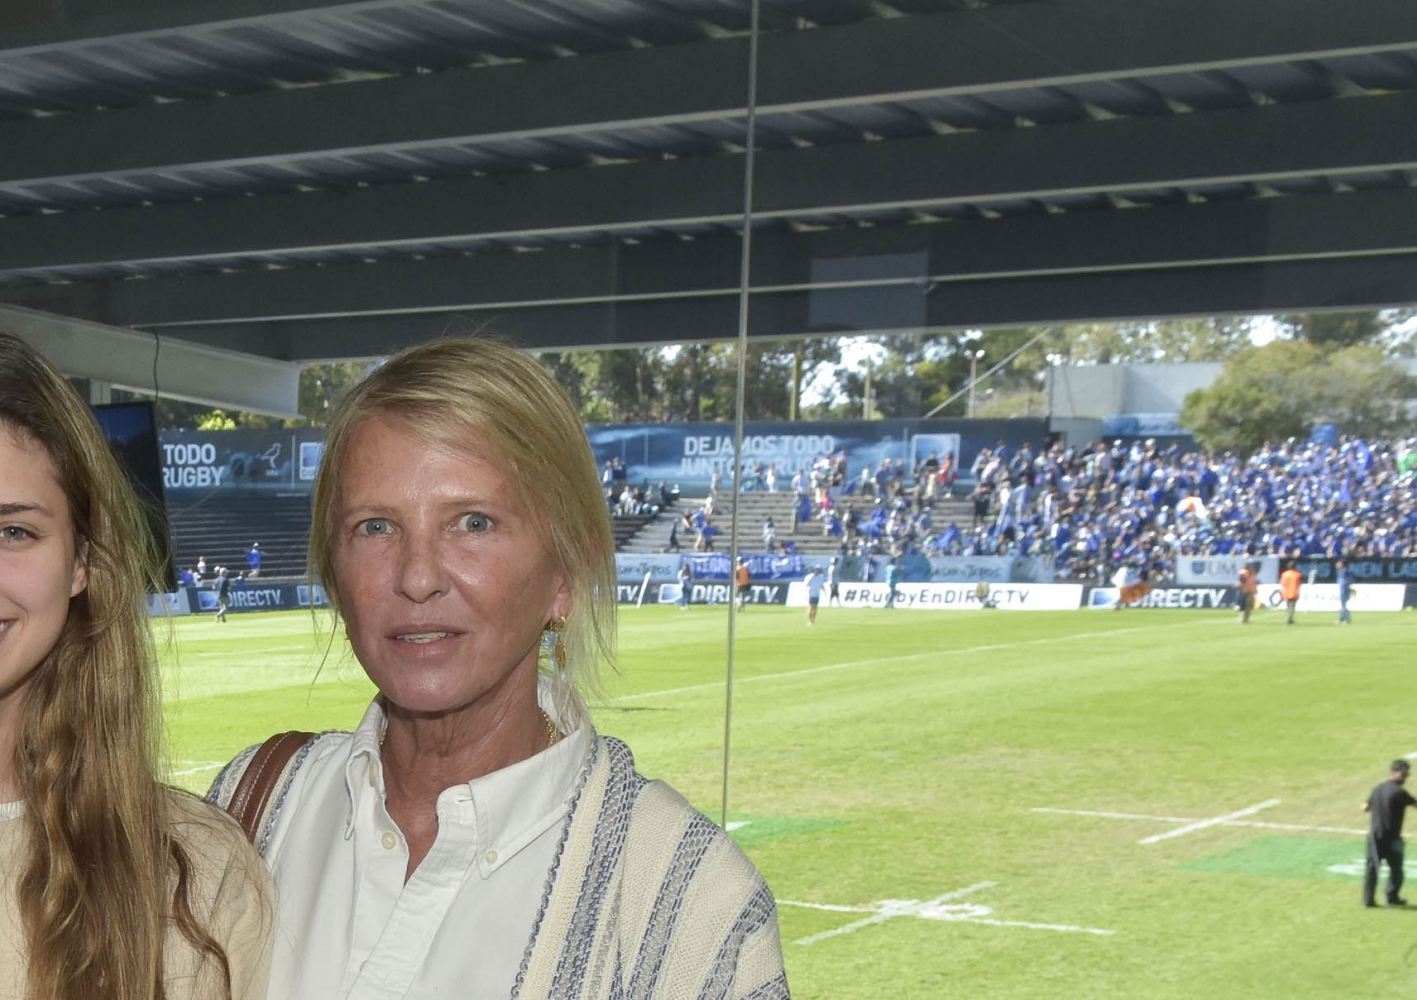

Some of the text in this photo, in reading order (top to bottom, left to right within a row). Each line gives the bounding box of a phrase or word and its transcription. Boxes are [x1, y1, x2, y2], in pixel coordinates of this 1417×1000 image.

[163, 443, 216, 466] TODO
[779, 435, 836, 455] TODO
[692, 584, 779, 604] DIRTV
[845, 588, 1029, 606] #RubyEnDIRCTV
[1130, 588, 1227, 609] IRECTV
